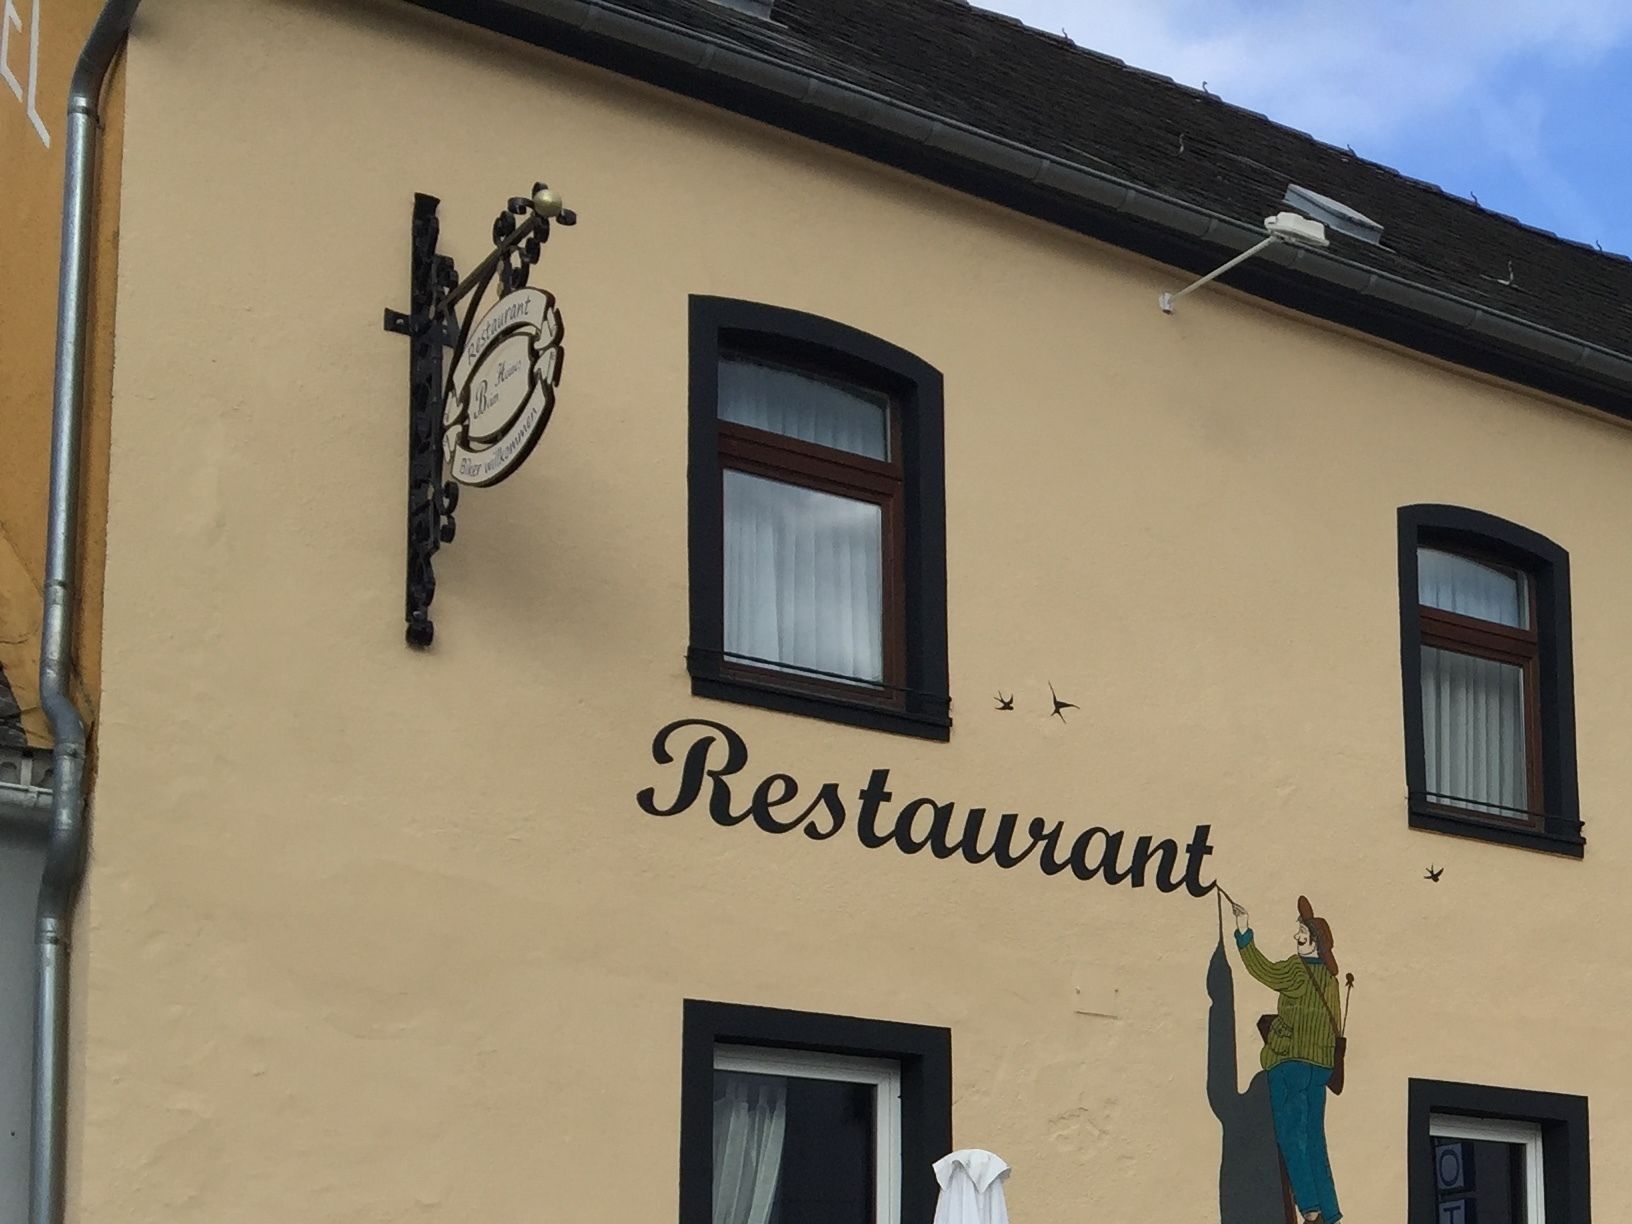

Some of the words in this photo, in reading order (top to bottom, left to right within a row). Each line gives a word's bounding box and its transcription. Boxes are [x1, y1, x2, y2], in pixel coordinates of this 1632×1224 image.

[467, 296, 532, 366] Restaurant
[484, 406, 538, 474] willkommen
[636, 718, 1219, 898] Restaurant
